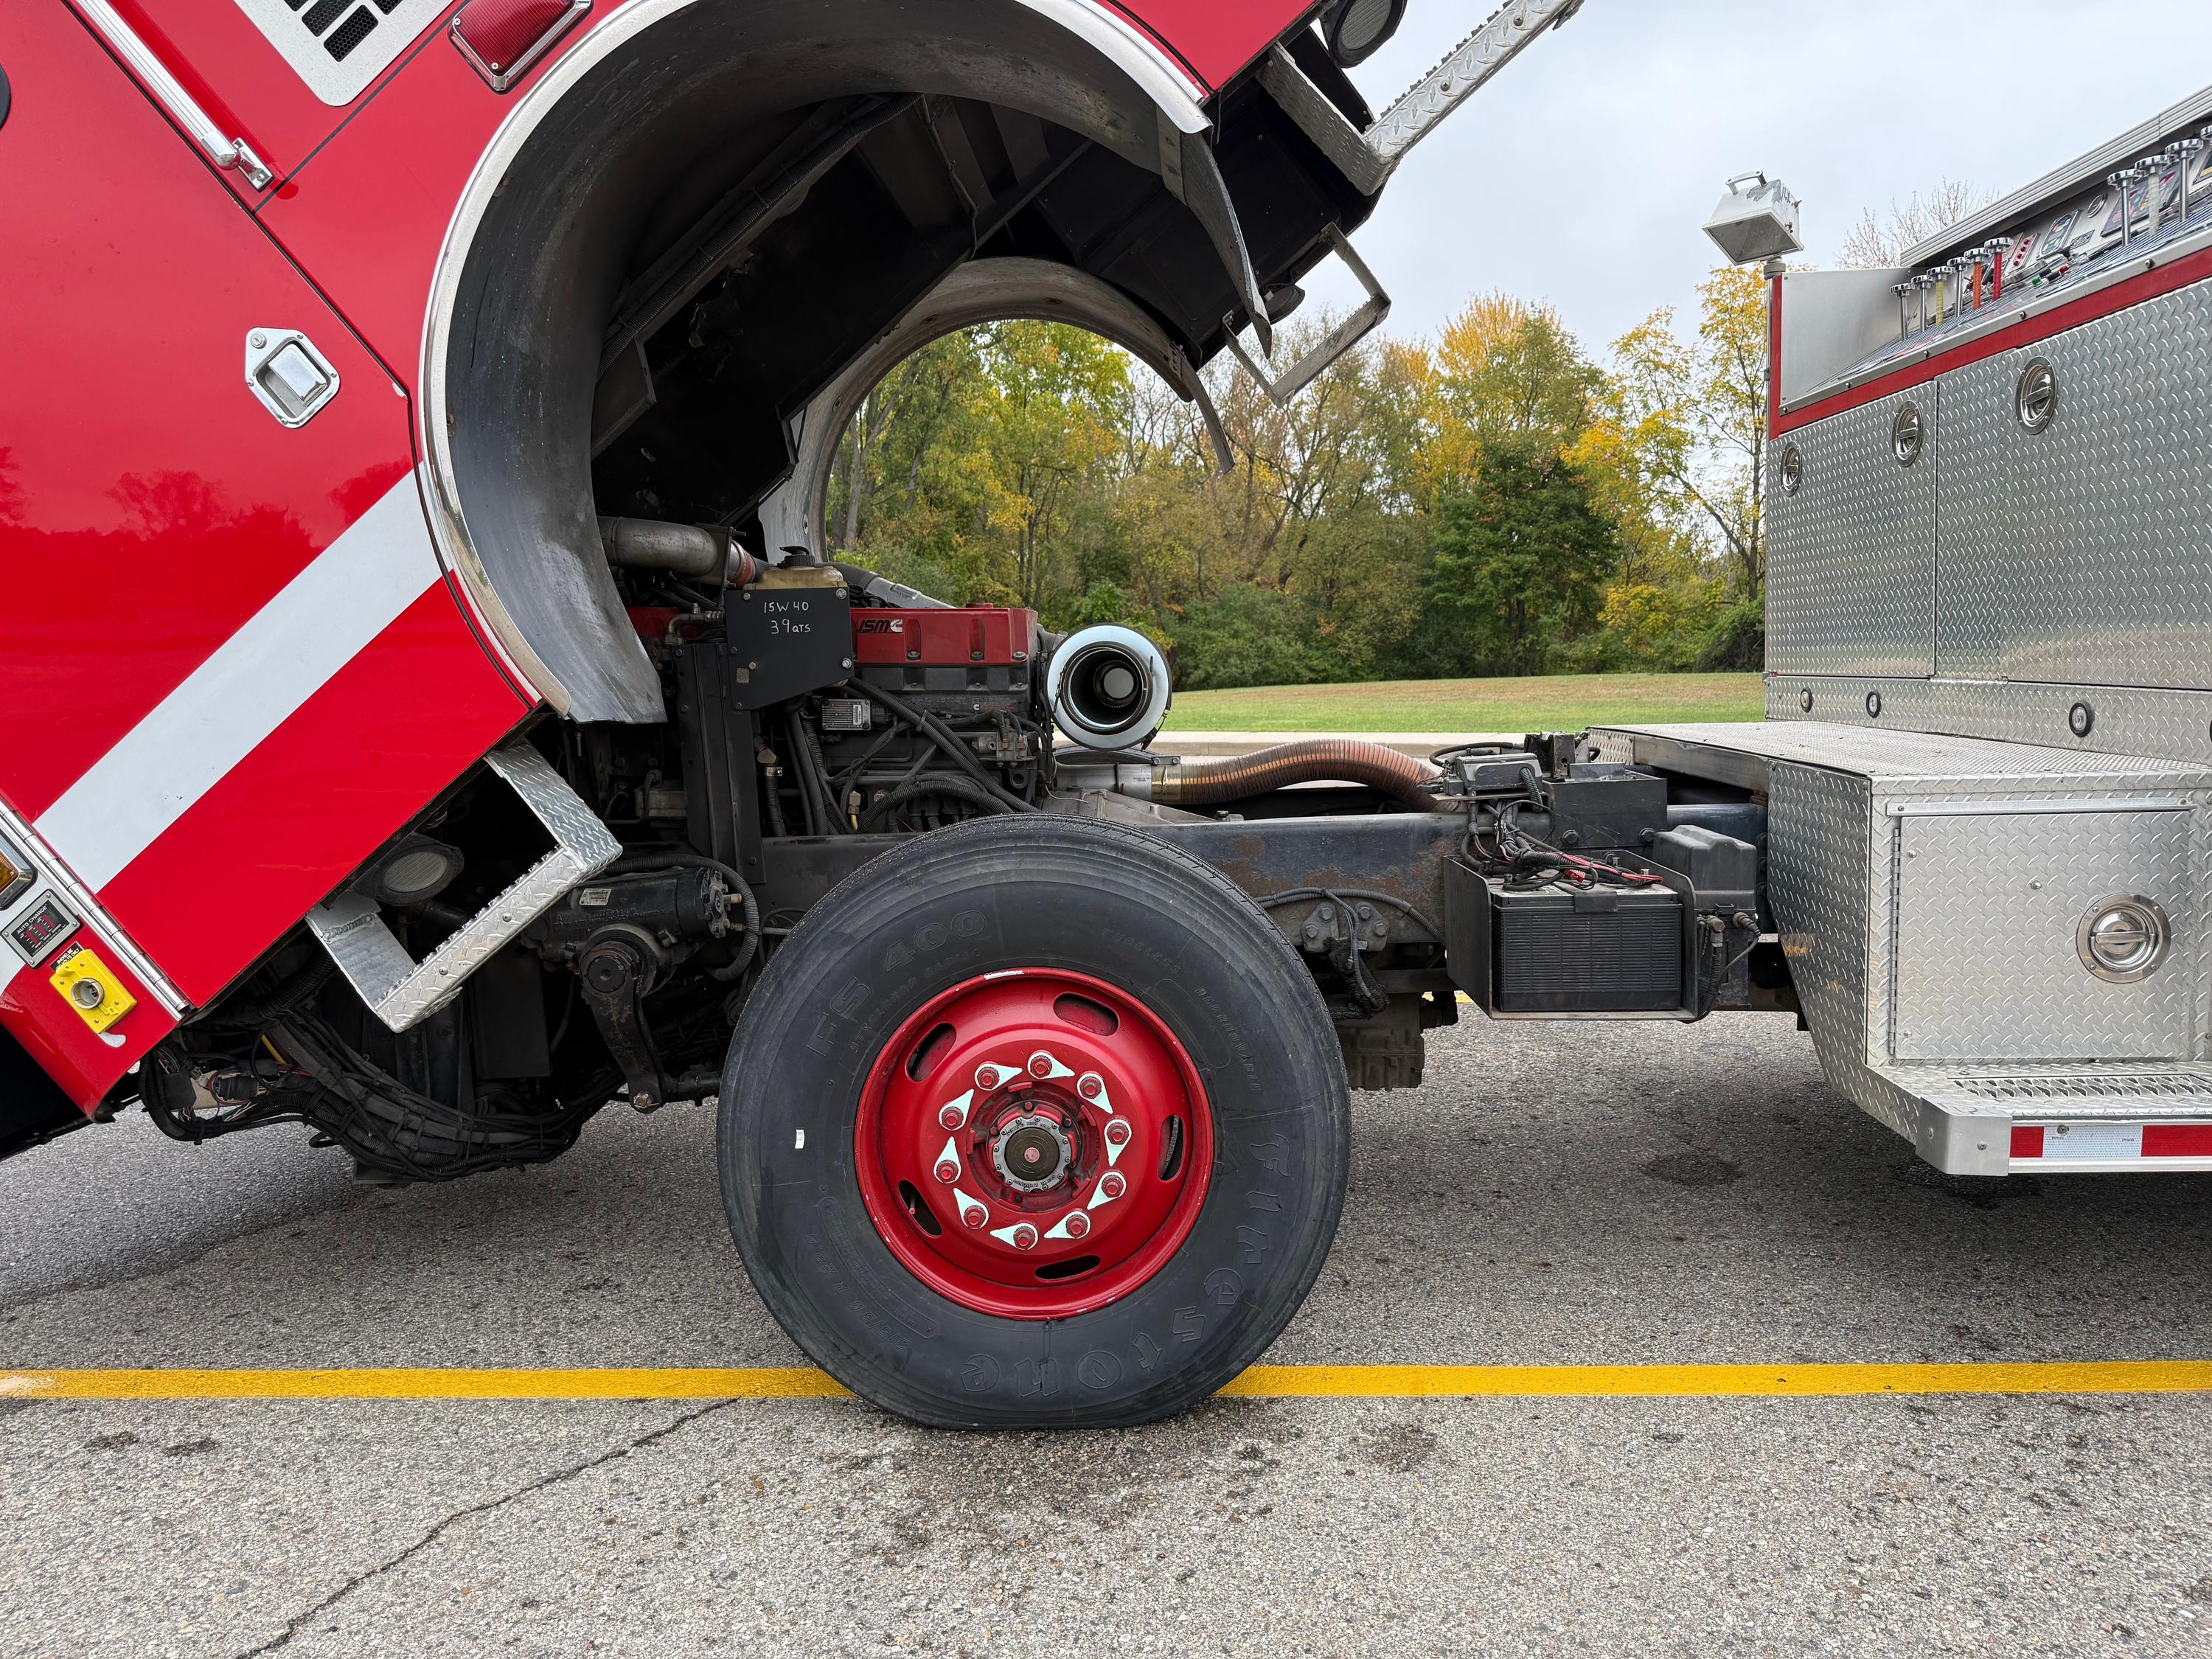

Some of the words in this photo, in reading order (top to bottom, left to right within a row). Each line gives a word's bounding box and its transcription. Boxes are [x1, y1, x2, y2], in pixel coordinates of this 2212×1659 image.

[793, 601, 809, 611] 40
[17, 921, 29, 934] AUTO
[29, 905, 48, 923] CHARGE
[884, 909, 986, 973] 400
